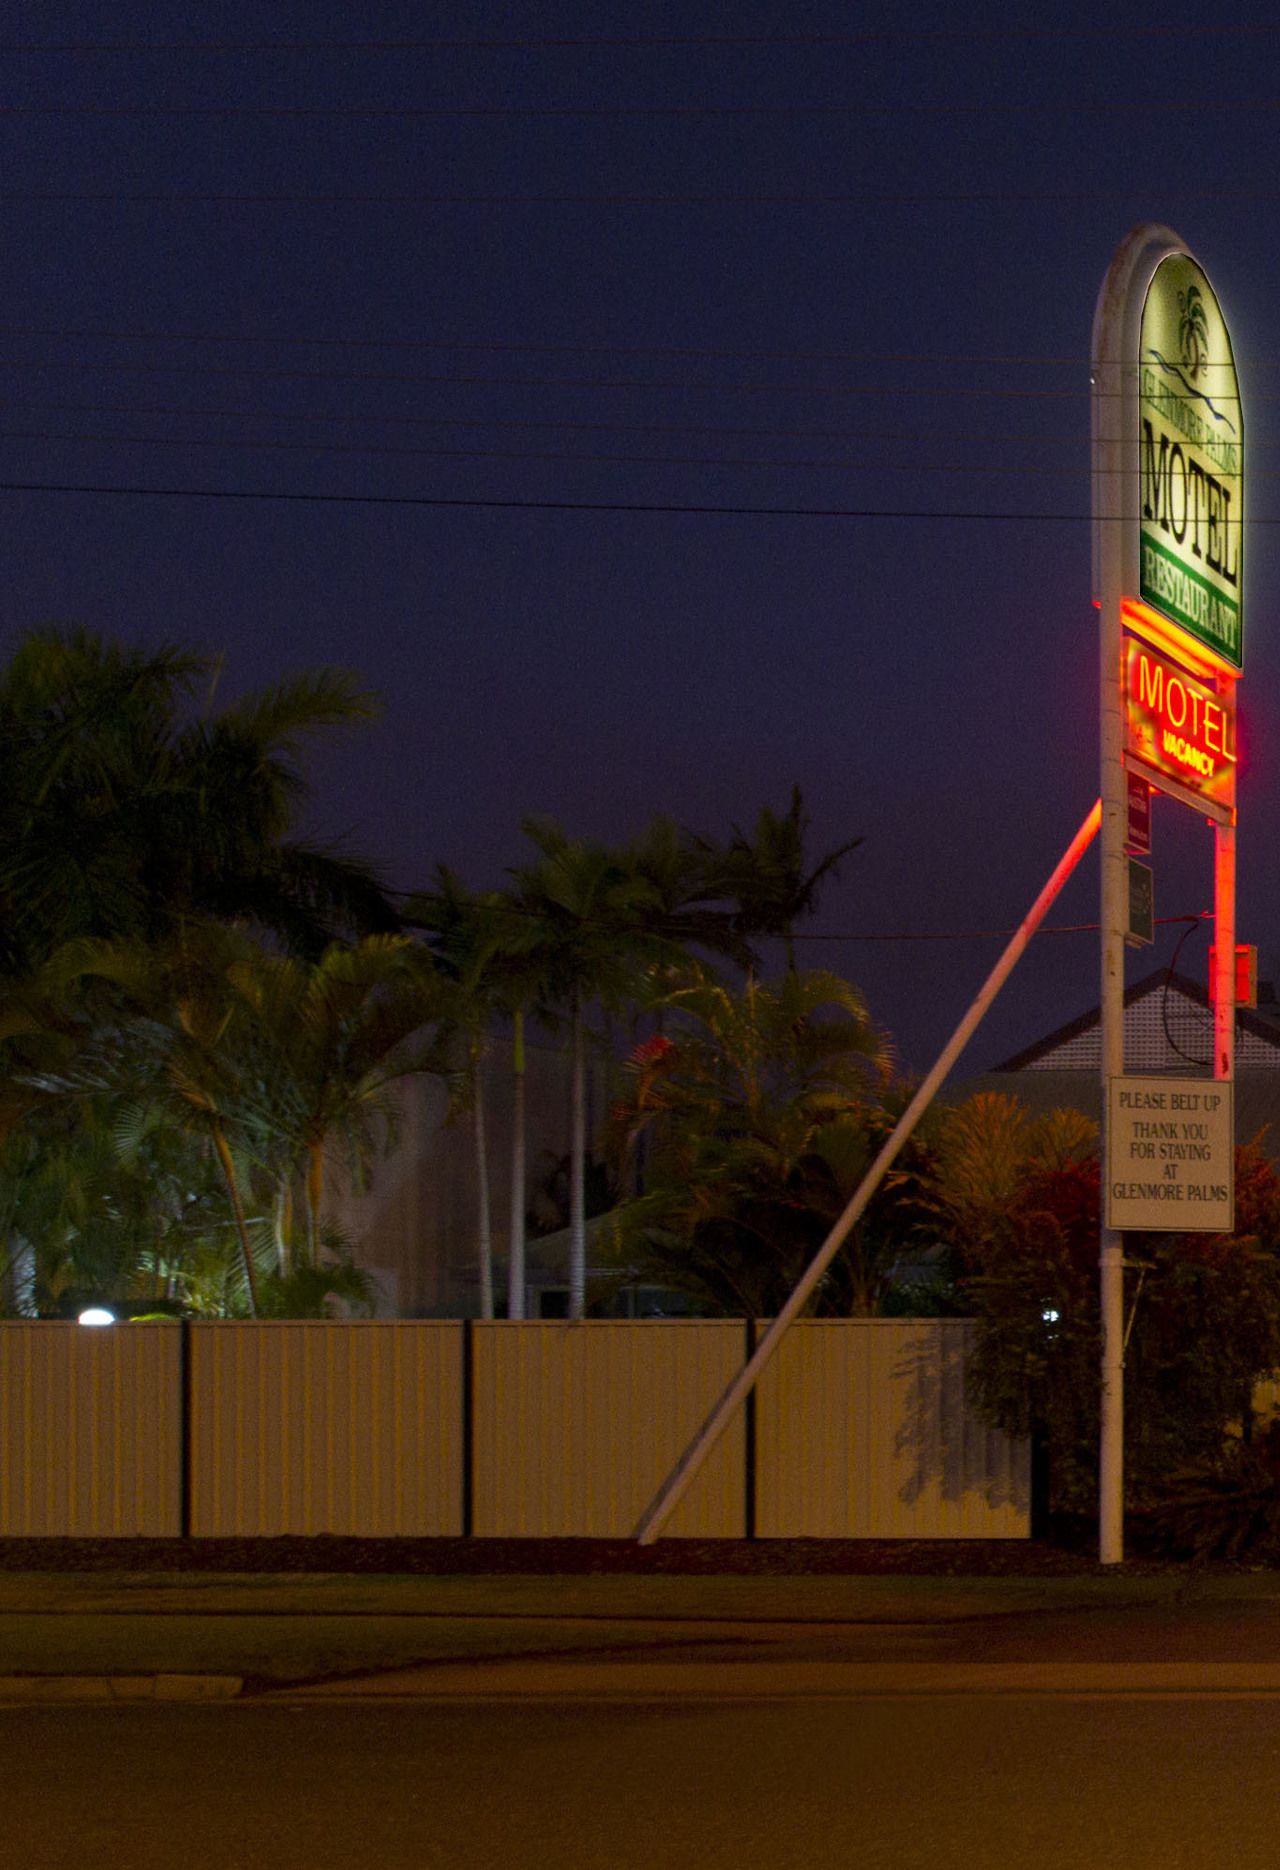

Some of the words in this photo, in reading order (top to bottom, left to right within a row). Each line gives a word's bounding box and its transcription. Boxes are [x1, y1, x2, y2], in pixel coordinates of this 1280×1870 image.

[1206, 423, 1237, 480] PALMS
[1143, 416, 1238, 588] MOTEL
[1144, 545, 1237, 650] RESTAURANT
[1140, 655, 1237, 762] MOTEL
[1163, 729, 1215, 777] VACANCY
[1119, 1092, 1168, 1110] PLEASE
[1171, 1094, 1201, 1111] BELT
[1204, 1095, 1221, 1112] UP
[1132, 1121, 1178, 1139] THANK
[1182, 1124, 1209, 1140] YOU
[1130, 1143, 1155, 1159] FOR
[1159, 1144, 1212, 1161] STAYING
[1162, 1164, 1179, 1180] AT
[1112, 1183, 1184, 1200] GLENMORE
[1187, 1185, 1228, 1202] PALMS
